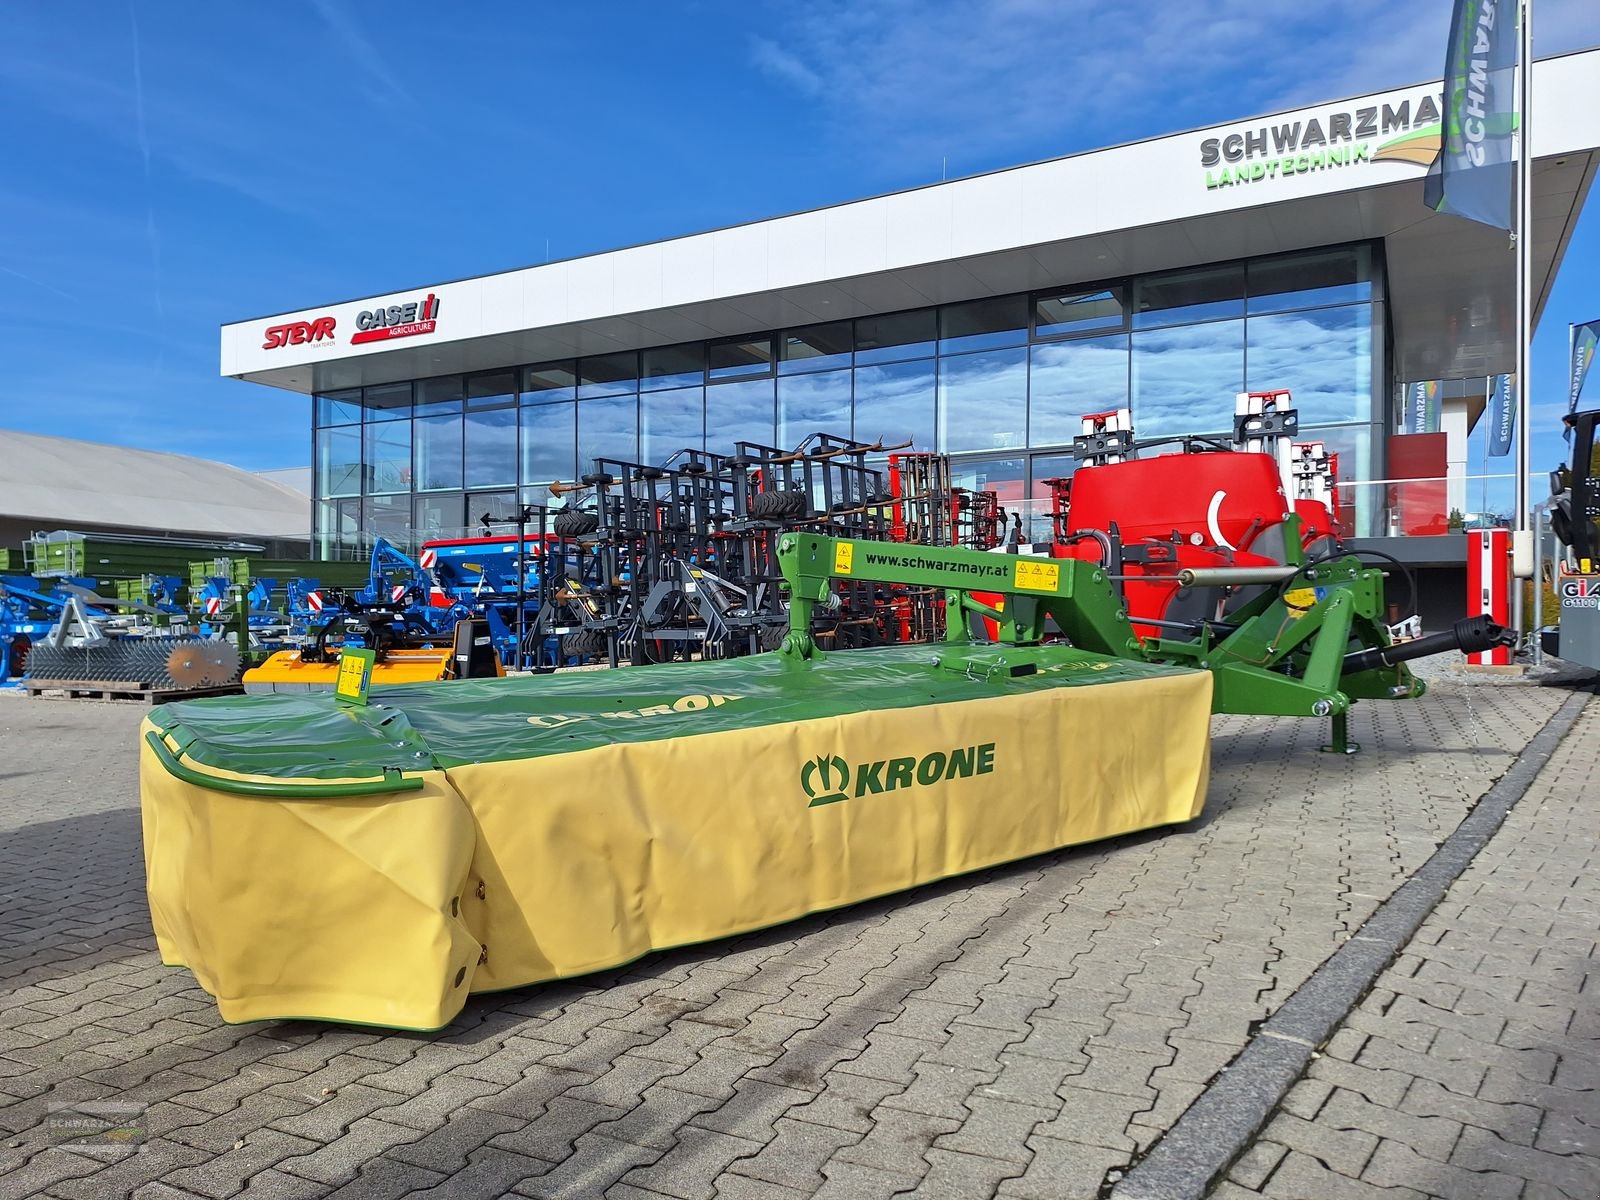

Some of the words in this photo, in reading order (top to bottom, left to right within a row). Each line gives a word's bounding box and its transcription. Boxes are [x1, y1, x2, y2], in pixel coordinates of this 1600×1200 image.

[1200, 93, 1443, 167] SCHWARZMA
[1205, 142, 1369, 190] LANDTECHNIK
[356, 302, 418, 331] CASE
[389, 322, 432, 336] AGRICULTURE
[262, 317, 336, 350] STEYR
[865, 553, 1009, 577] www.schwarzmayr.at
[855, 743, 996, 798] KRONE
